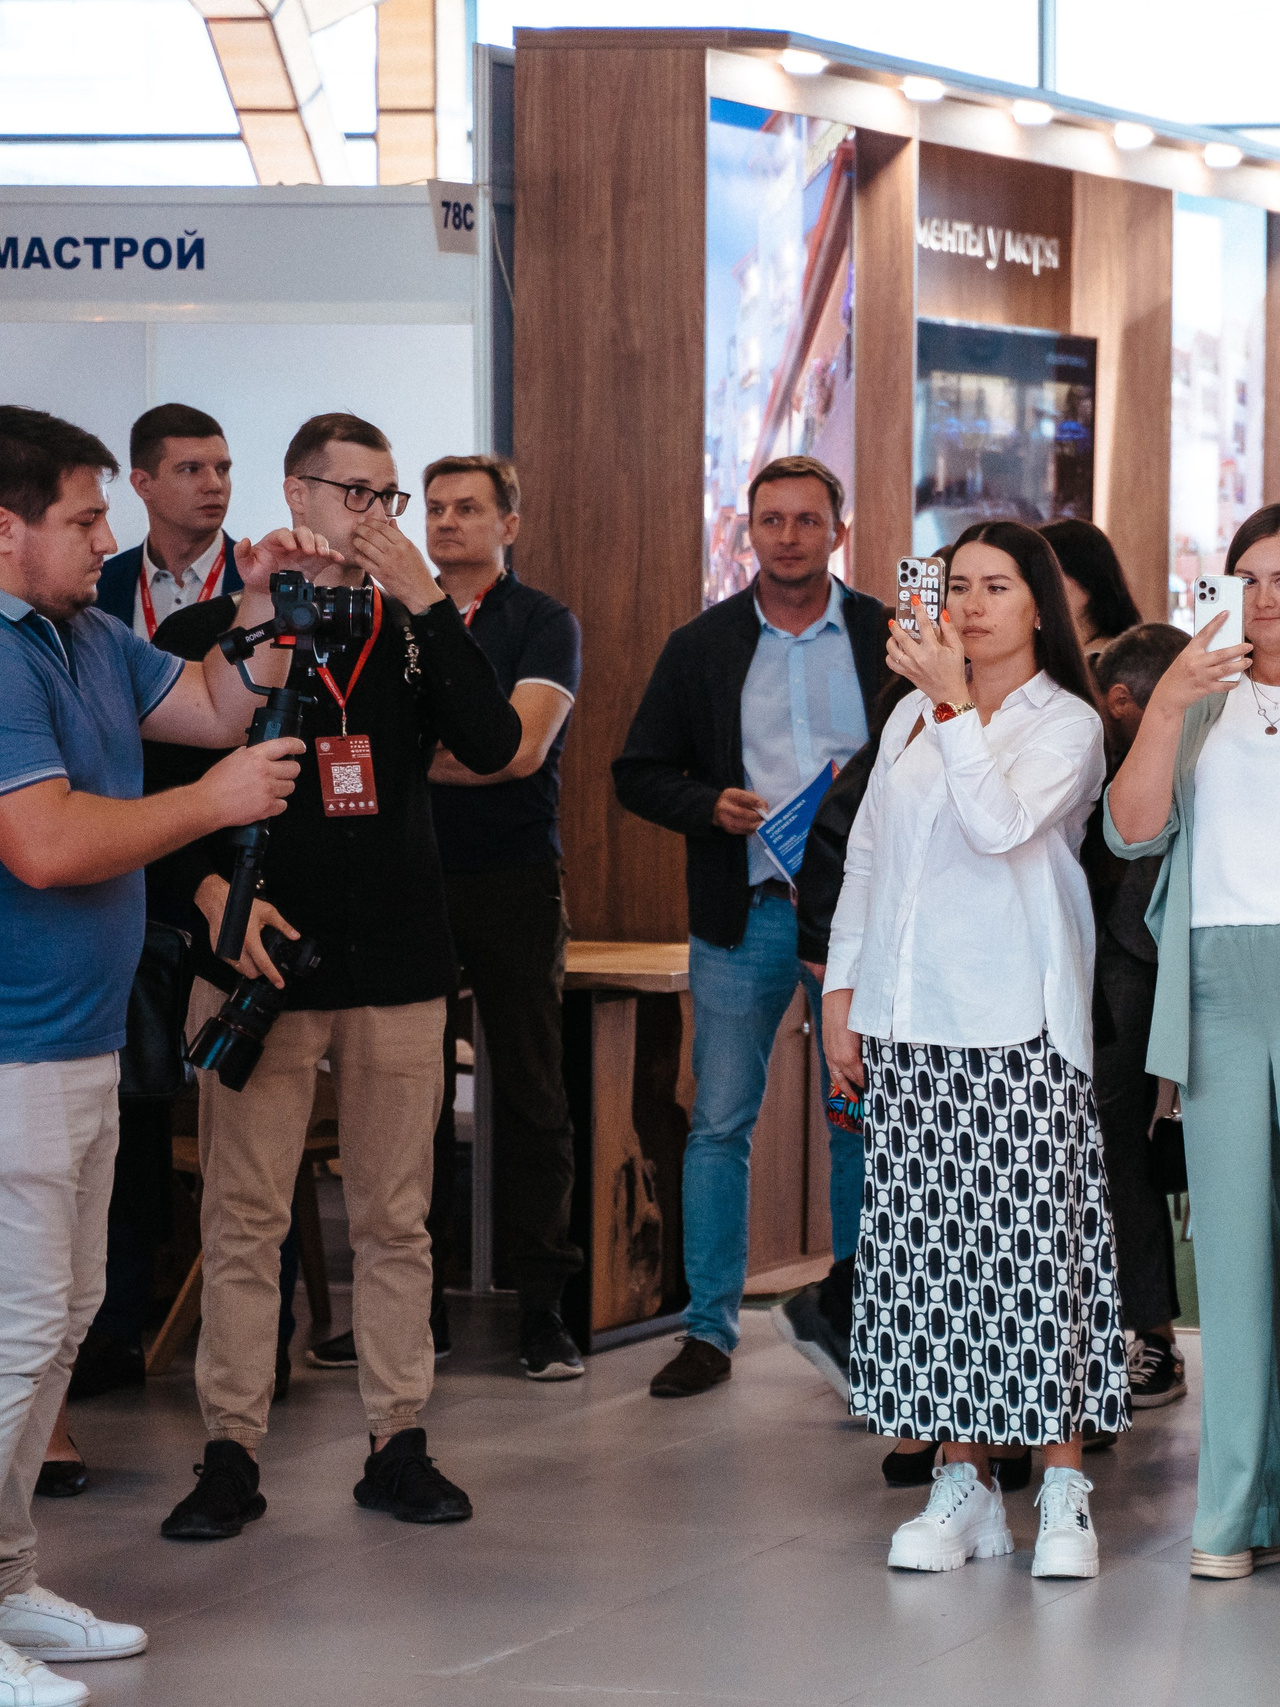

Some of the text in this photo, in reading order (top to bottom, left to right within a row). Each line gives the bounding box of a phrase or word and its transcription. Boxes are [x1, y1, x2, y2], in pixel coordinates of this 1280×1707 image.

[0, 229, 205, 270] МАСТРОЙ
[1004, 229, 1060, 276] моря
[245, 629, 265, 643] RONIN
